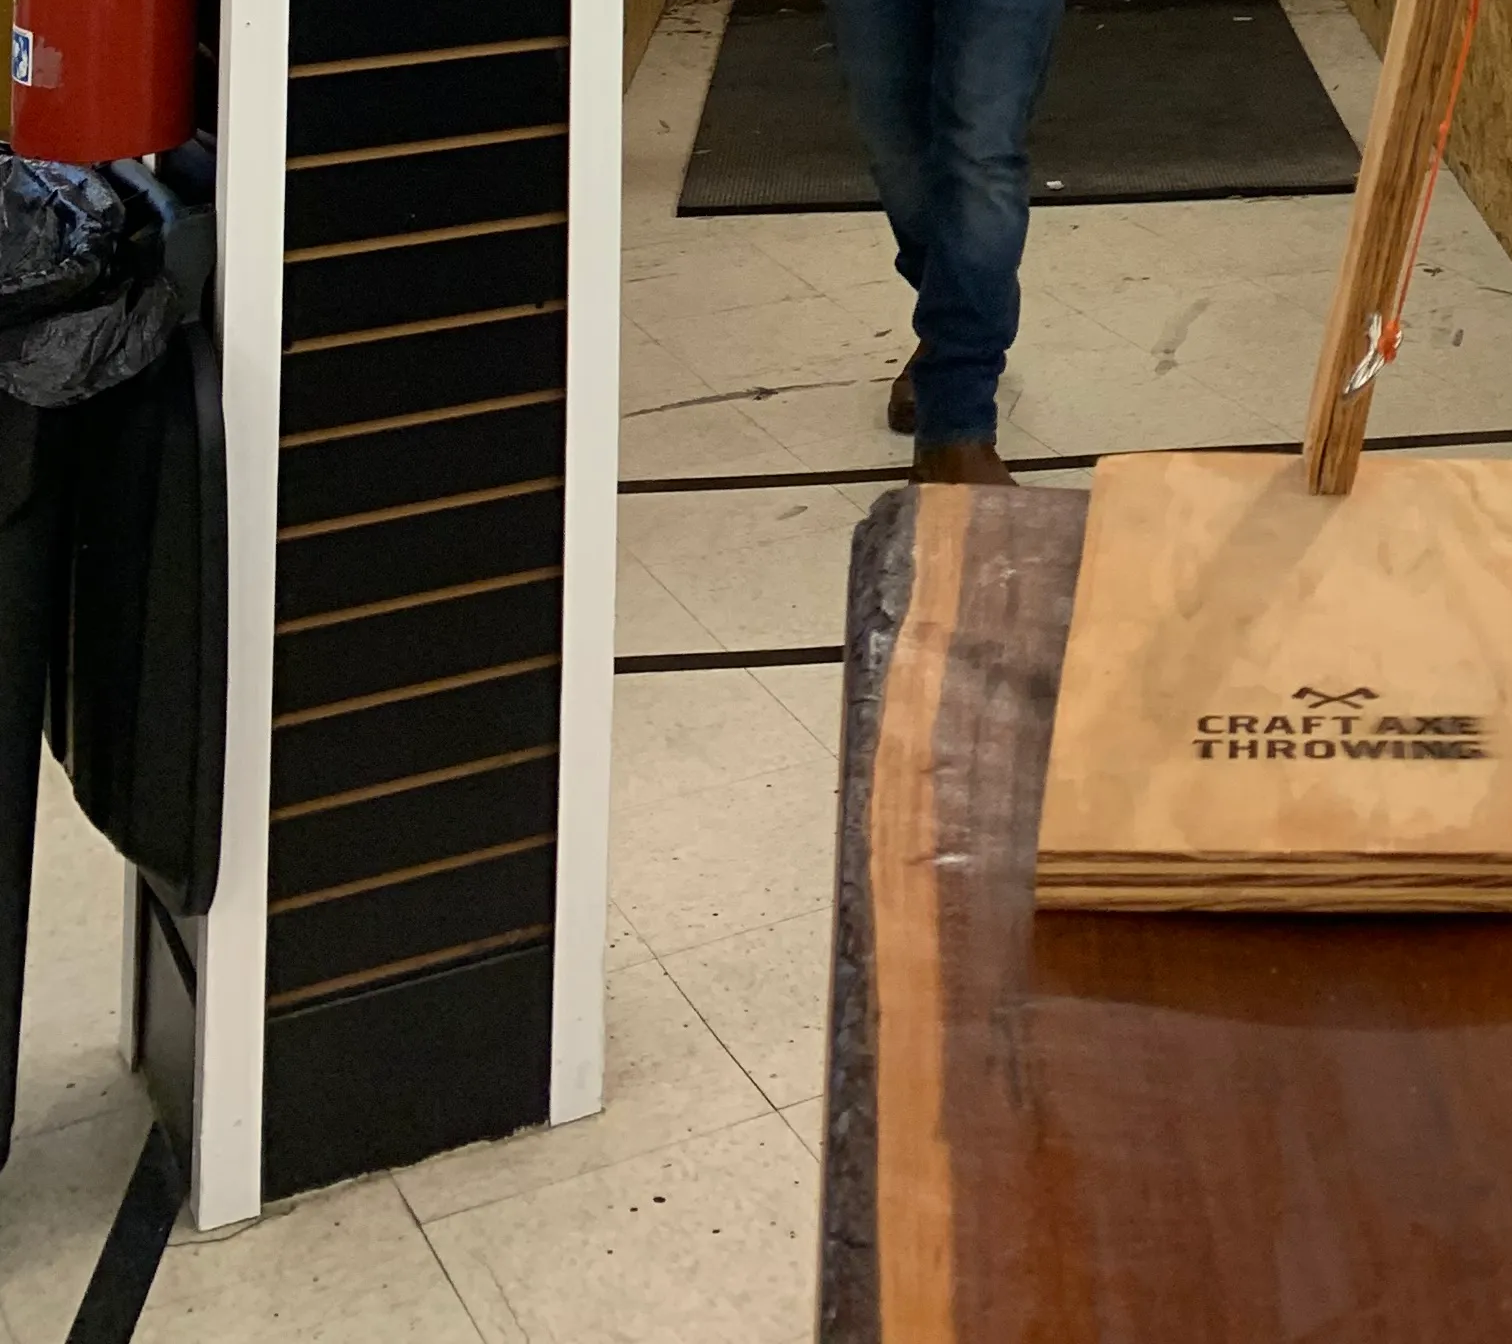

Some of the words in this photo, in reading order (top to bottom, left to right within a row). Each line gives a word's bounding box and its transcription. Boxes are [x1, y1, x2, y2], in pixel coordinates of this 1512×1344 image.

[1196, 714, 1362, 736] CRAFT
[1373, 715, 1486, 736] AXE
[1192, 738, 1494, 760] THROWING
